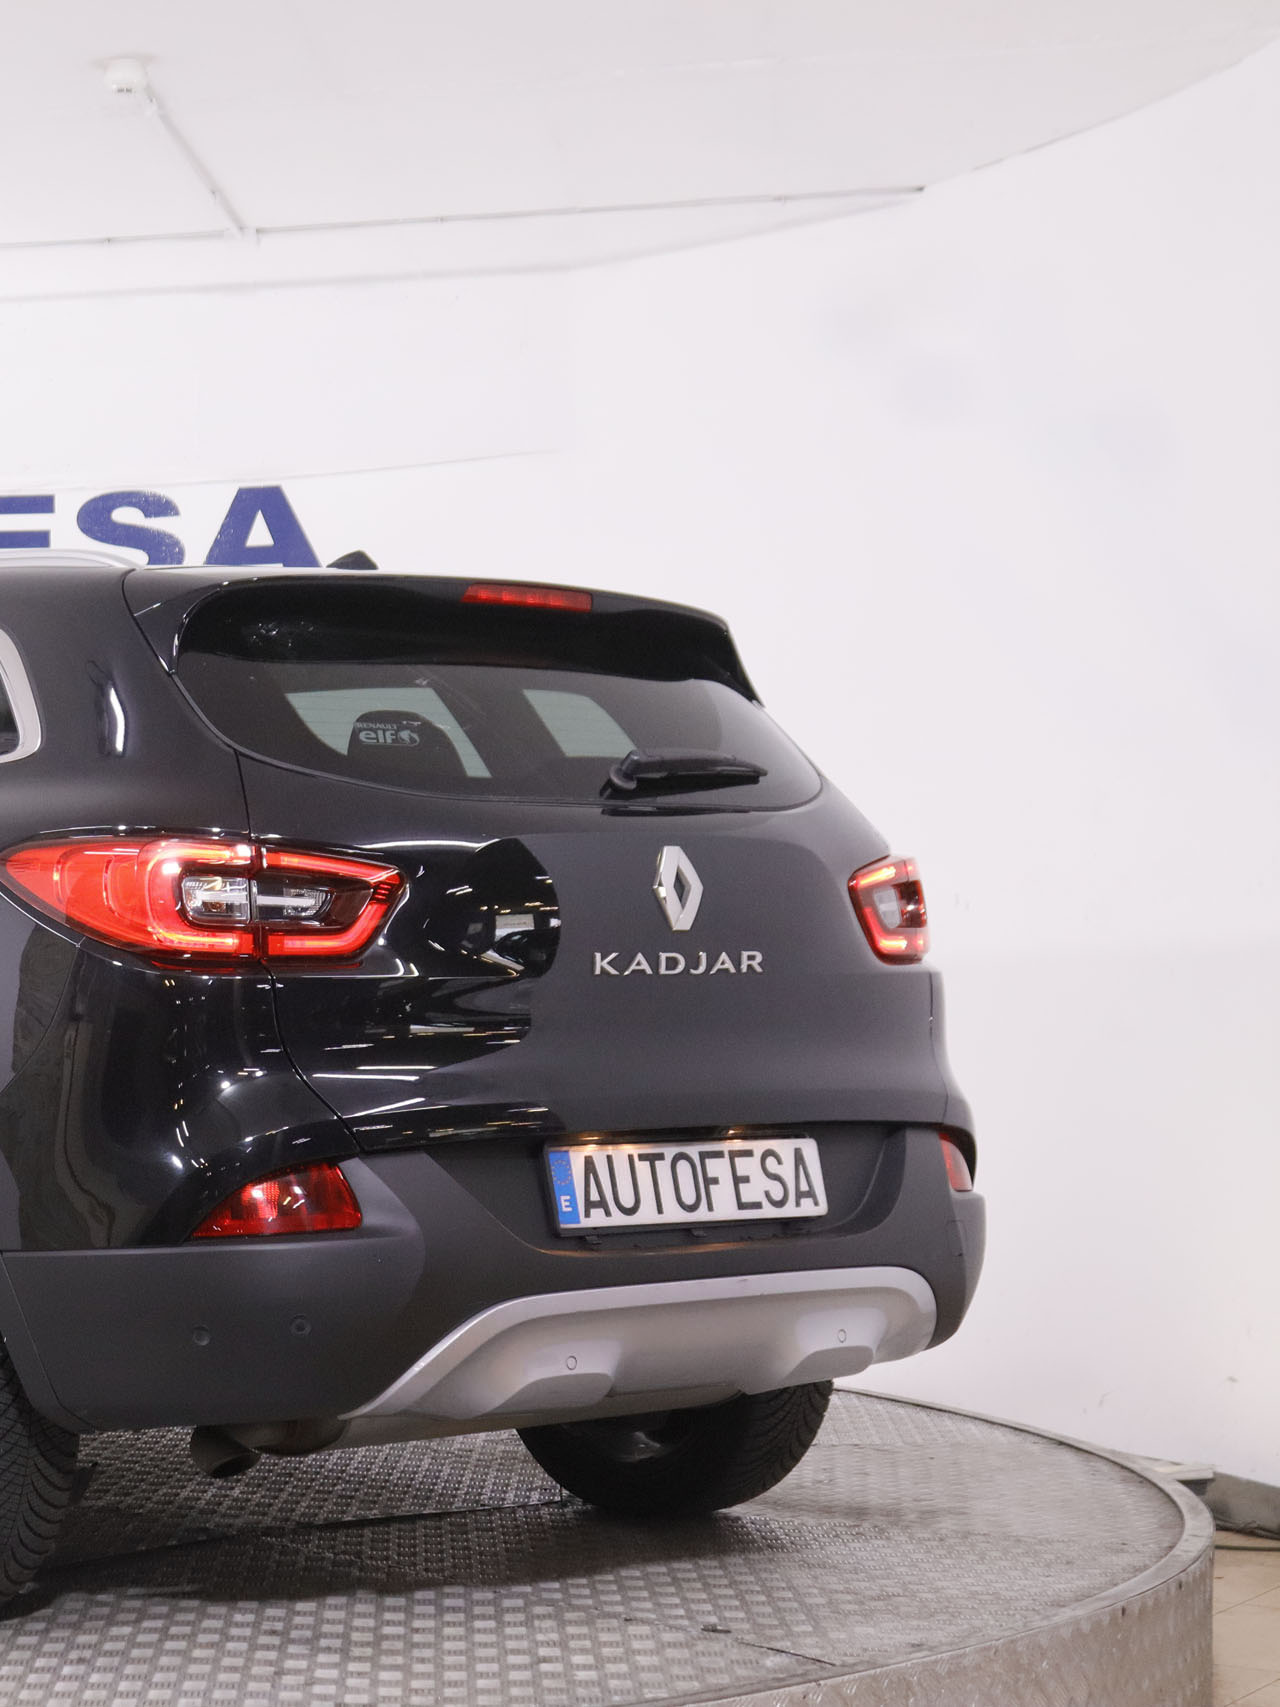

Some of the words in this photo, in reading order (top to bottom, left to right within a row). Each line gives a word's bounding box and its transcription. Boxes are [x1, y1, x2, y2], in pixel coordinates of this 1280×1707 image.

[359, 730, 396, 744] elf
[593, 950, 763, 975] KADJAR
[561, 1195, 573, 1212] E
[584, 1147, 819, 1219] AUTOFESA
